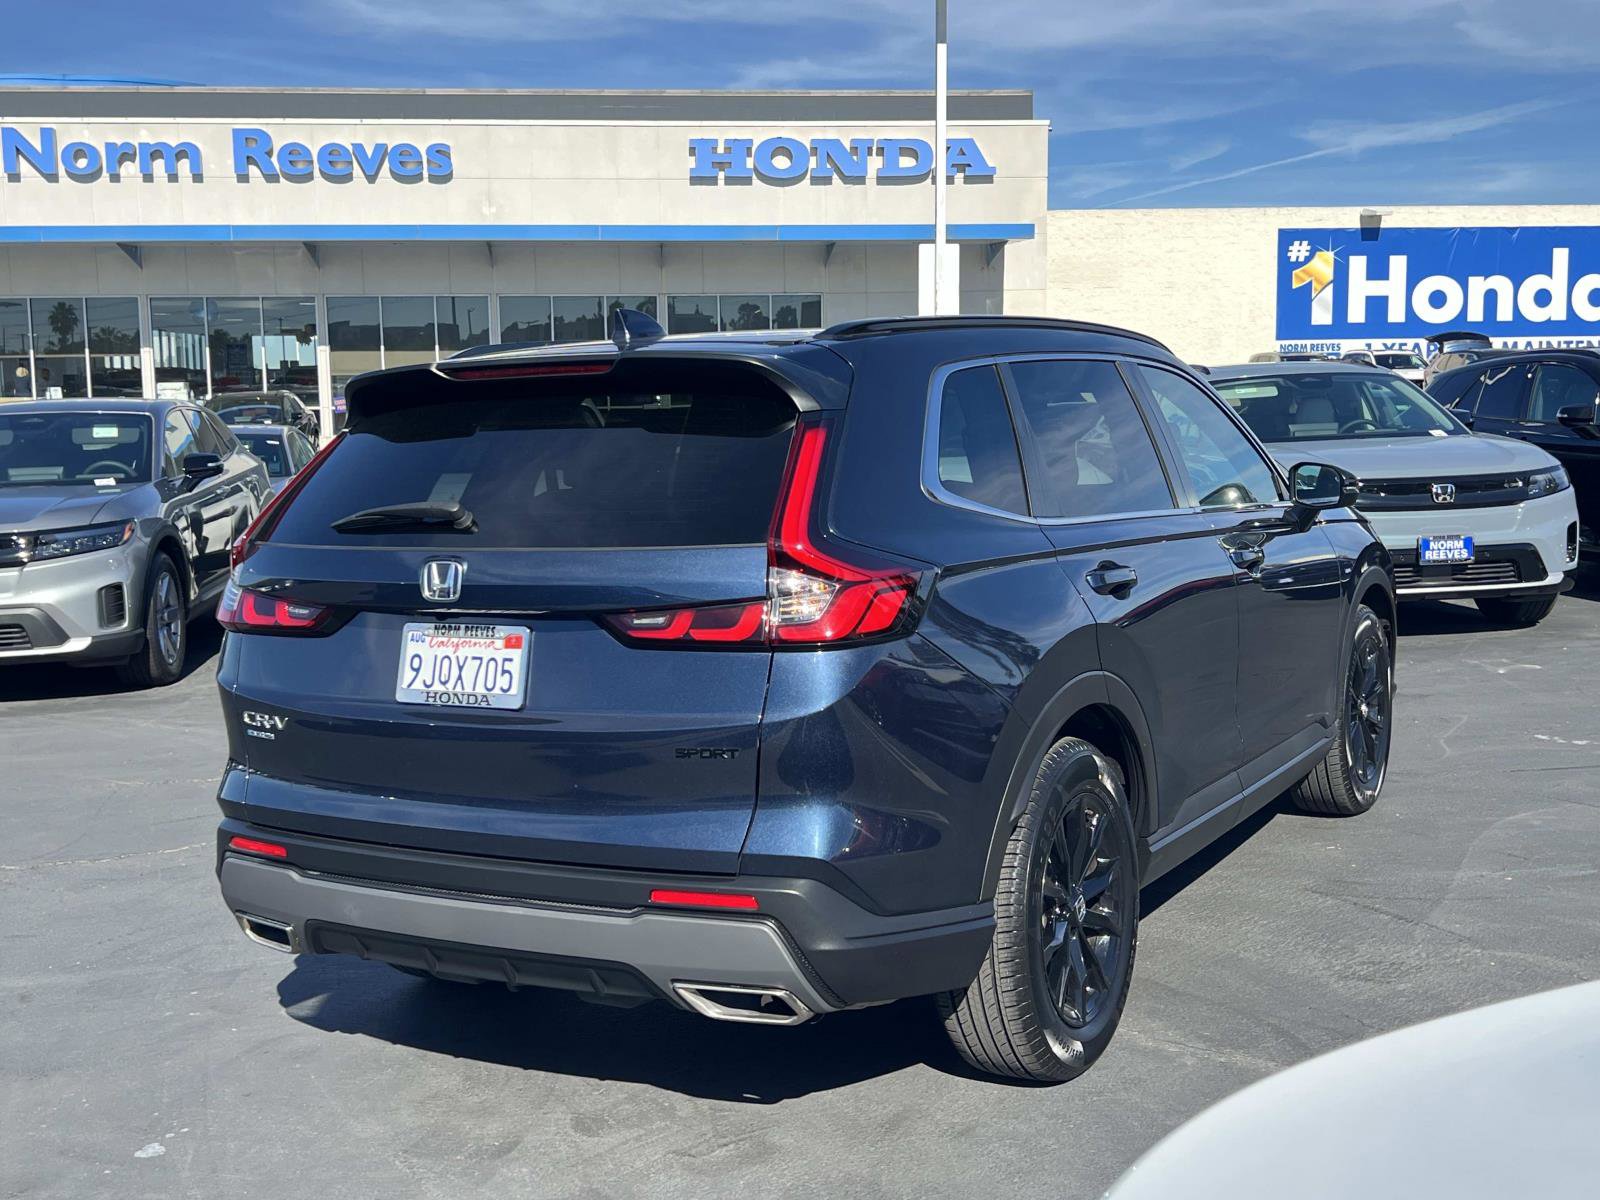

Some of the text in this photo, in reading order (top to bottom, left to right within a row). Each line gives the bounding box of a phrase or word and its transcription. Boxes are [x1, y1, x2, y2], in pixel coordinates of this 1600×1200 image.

[1, 126, 454, 178] Norm Reeves
[688, 136, 997, 182] HONDA
[1279, 342, 1342, 353] NORM REEVES
[1429, 540, 1465, 550] NORM
[1425, 548, 1469, 560] REEVES
[433, 624, 497, 638] NORM REEVES
[428, 635, 503, 654] California
[406, 652, 514, 694] 9JQX705
[424, 690, 492, 707] HONDA
[674, 747, 740, 760] SPORT
